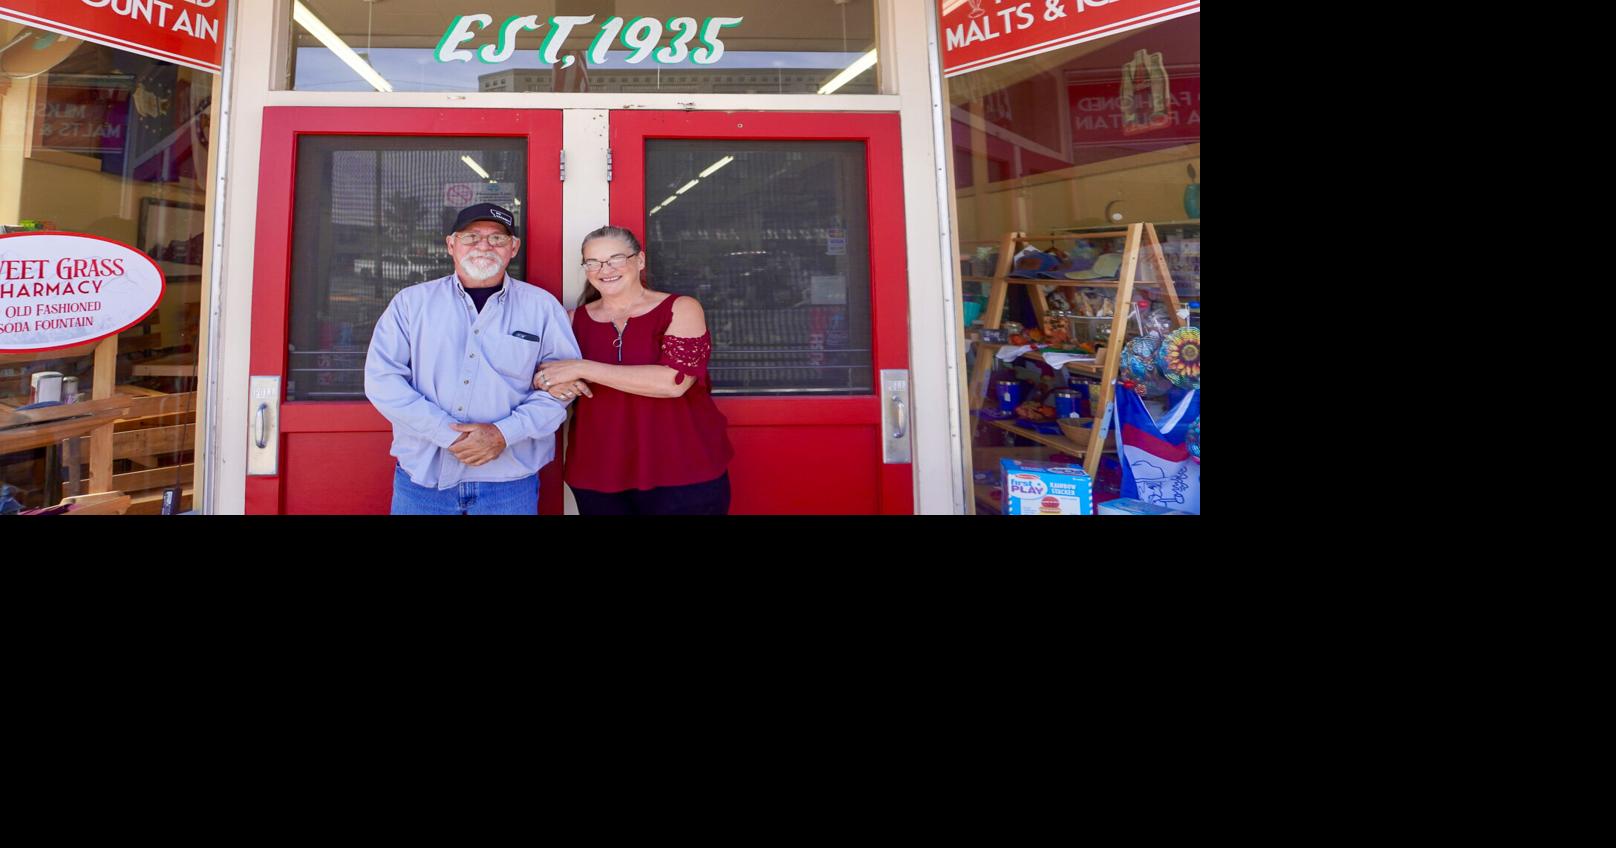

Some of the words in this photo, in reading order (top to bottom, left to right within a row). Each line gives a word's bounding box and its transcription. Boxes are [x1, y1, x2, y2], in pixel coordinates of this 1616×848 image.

[81, 0, 219, 44] UNTAIN
[946, 2, 1034, 51] MALTS
[587, 15, 744, 65] 1935
[0, 259, 49, 280] EET
[56, 257, 125, 280] GRASS
[5, 305, 32, 318] OLD
[36, 301, 102, 316] FASHIONED
[0, 321, 30, 334] SODA
[35, 316, 94, 331] FOUNTAIN
[1011, 485, 1043, 495] PLAY
